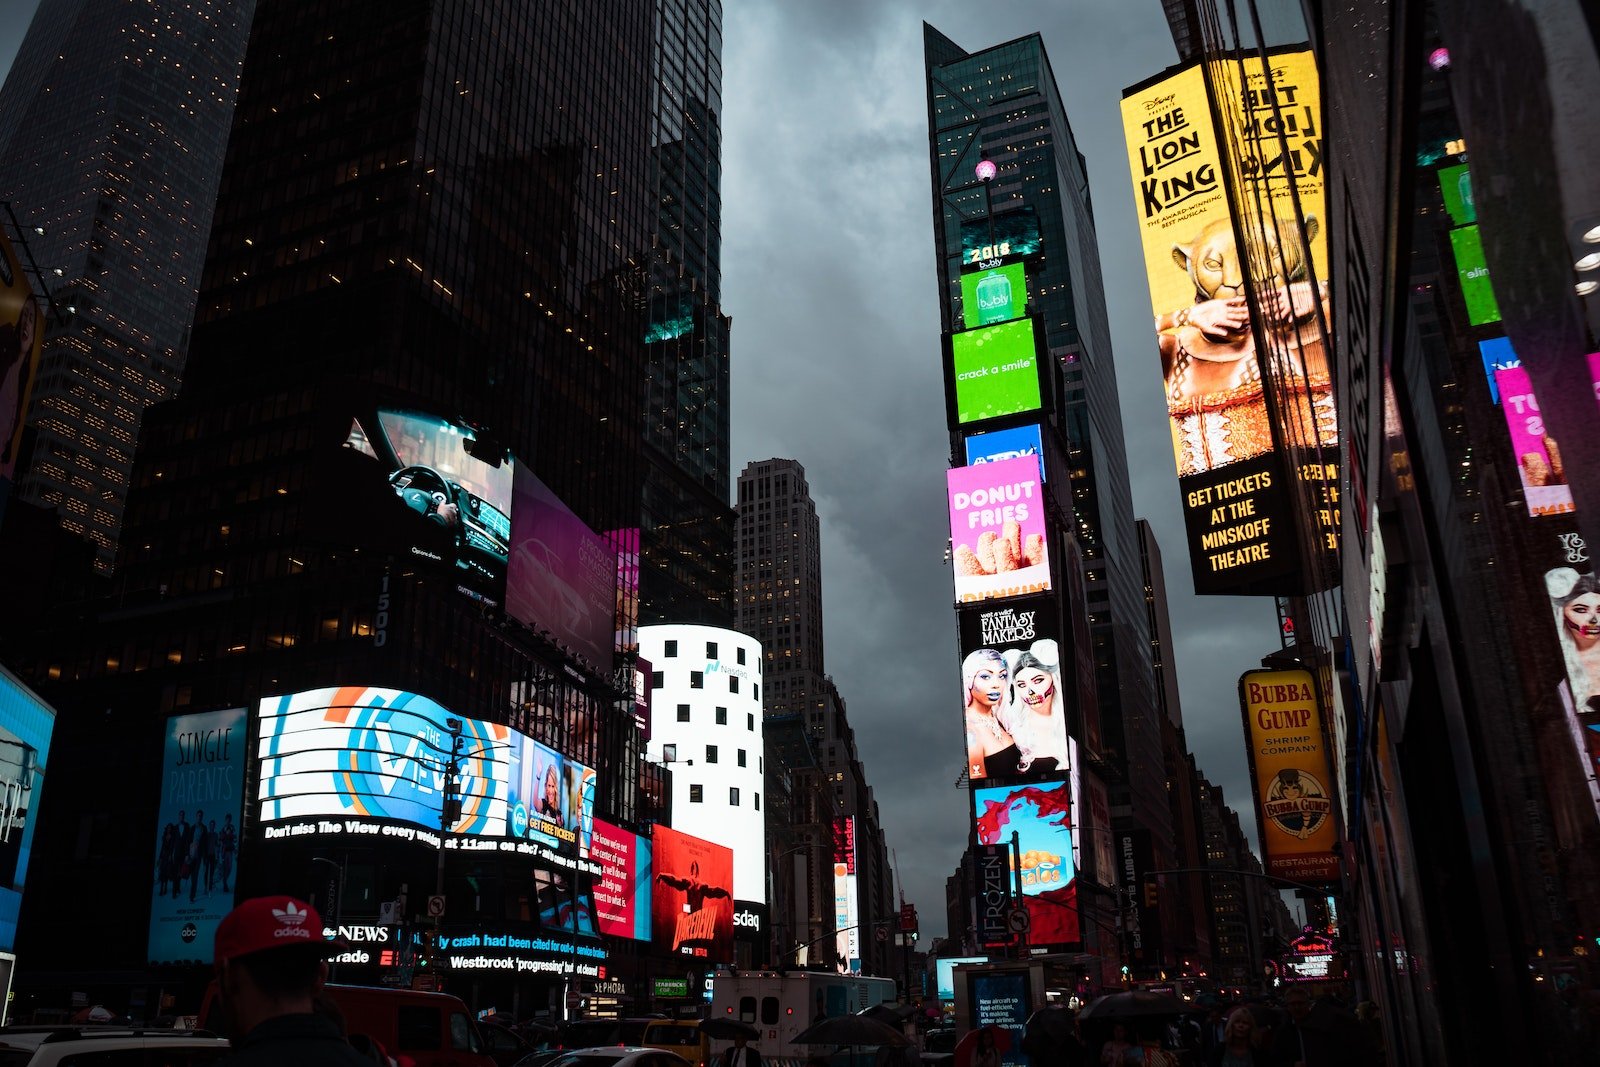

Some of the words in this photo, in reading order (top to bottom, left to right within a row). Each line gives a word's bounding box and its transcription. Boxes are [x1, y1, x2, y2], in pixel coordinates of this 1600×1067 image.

[1142, 94, 1175, 110] Disney
[1143, 107, 1185, 138] THE
[1140, 131, 1200, 177] LION
[1141, 164, 1216, 218] KING
[1147, 218, 1160, 227] THE
[1161, 194, 1222, 221] AWARD-WINNING
[1161, 220, 1176, 229] BEST
[1177, 208, 1208, 223] MUSICAL
[971, 242, 1010, 262] 2018
[958, 367, 988, 380] crack
[991, 366, 998, 374] a
[953, 480, 1035, 510] DONUT
[1188, 487, 1212, 508] GET
[1215, 471, 1271, 500] TICKETS
[968, 503, 1029, 529] FRIES
[1211, 506, 1226, 525] AT
[1228, 499, 1256, 520] THE
[1201, 518, 1270, 550] MINSKOFF
[1209, 542, 1271, 571] THEATRE
[373, 574, 390, 648] 1500
[981, 611, 1036, 631] FANTASY
[982, 625, 1035, 645] MAKERS
[720, 665, 748, 679] Nasdaq
[1248, 683, 1312, 705] BUBBA
[1257, 708, 1311, 730] GUMP
[426, 725, 441, 744] THE
[1265, 735, 1311, 746] SHRIMP
[176, 728, 232, 766] SINGLE
[1260, 745, 1317, 755] COMPANY
[170, 765, 234, 805] PARENTS
[1266, 801, 1299, 816] BUBBA
[1301, 798, 1329, 812] GUMP
[265, 822, 291, 838] Don't
[291, 822, 316, 836] miss
[318, 821, 343, 834] The
[345, 820, 380, 835] View
[382, 824, 416, 841] every
[444, 838, 459, 849] at
[460, 839, 497, 850] 11am
[500, 841, 515, 851] on
[517, 842, 539, 855] abc7
[529, 818, 541, 831] GET
[541, 821, 554, 836] FREE
[554, 827, 576, 843] TICKETS!
[592, 831, 599, 843] We
[844, 818, 853, 850] Locker
[578, 860, 588, 871] The
[612, 853, 617, 862] of
[1271, 857, 1339, 868] RESTAURANT
[1124, 859, 1136, 881] DUTY
[1284, 868, 1329, 878] MARKET
[606, 878, 615, 892] help
[983, 854, 1008, 932] FROZEN
[672, 904, 719, 951] DAREDEVIL
[733, 910, 760, 932] sdaq
[181, 928, 197, 937] abc
[274, 926, 310, 938] adidas
[322, 928, 337, 937] abc
[338, 926, 388, 942] NEWS
[452, 934, 480, 948] crash
[483, 934, 506, 947] had
[508, 935, 531, 949] been
[532, 938, 550, 951] cited
[551, 939, 560, 951] for
[328, 950, 370, 963] rade
[450, 956, 514, 970] Westbrook
[515, 958, 565, 974] 'progressing'
[565, 961, 575, 973] but
[594, 982, 626, 994] SEPHORA
